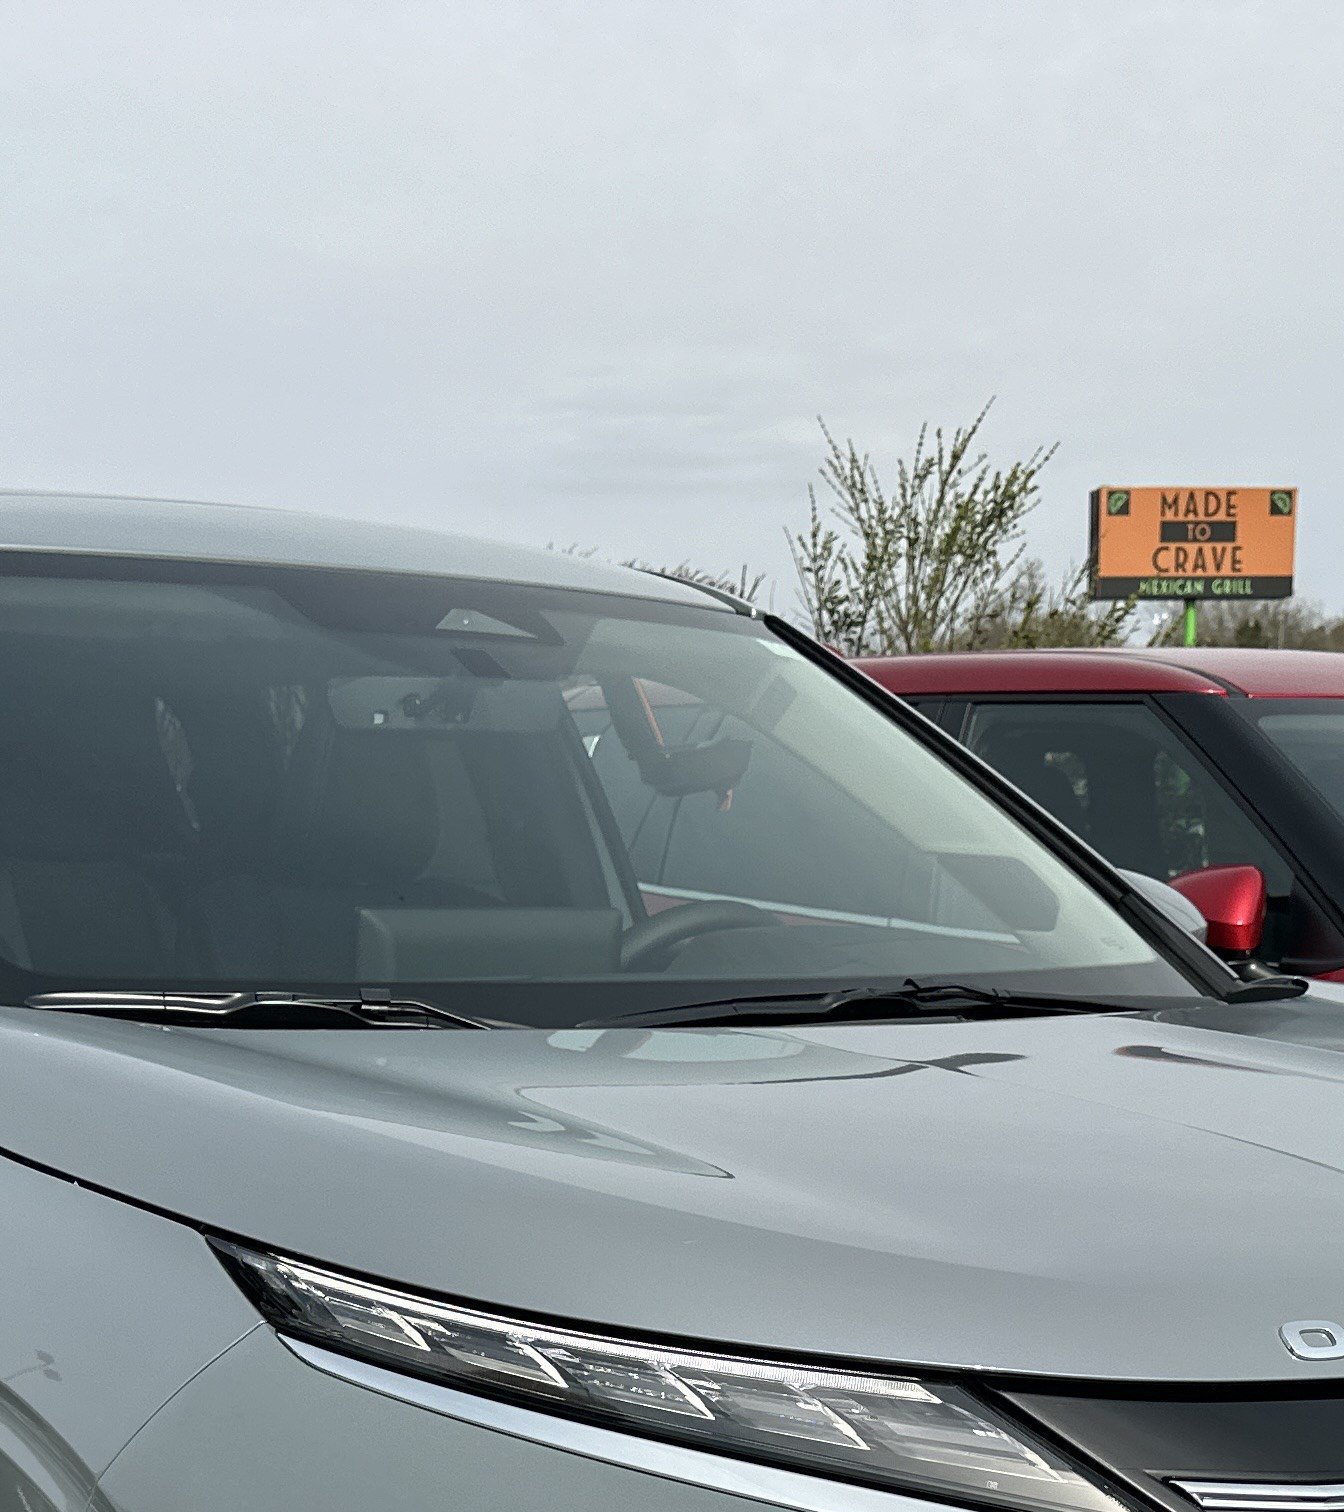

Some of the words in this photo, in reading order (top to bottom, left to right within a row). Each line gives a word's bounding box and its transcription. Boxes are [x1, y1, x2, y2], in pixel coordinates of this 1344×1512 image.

[1160, 490, 1239, 518] MADE
[1186, 523, 1211, 541] TO
[1151, 545, 1243, 573] CRAVE
[1138, 578, 1204, 596] MEXICAN
[1211, 578, 1253, 596] GRILL
